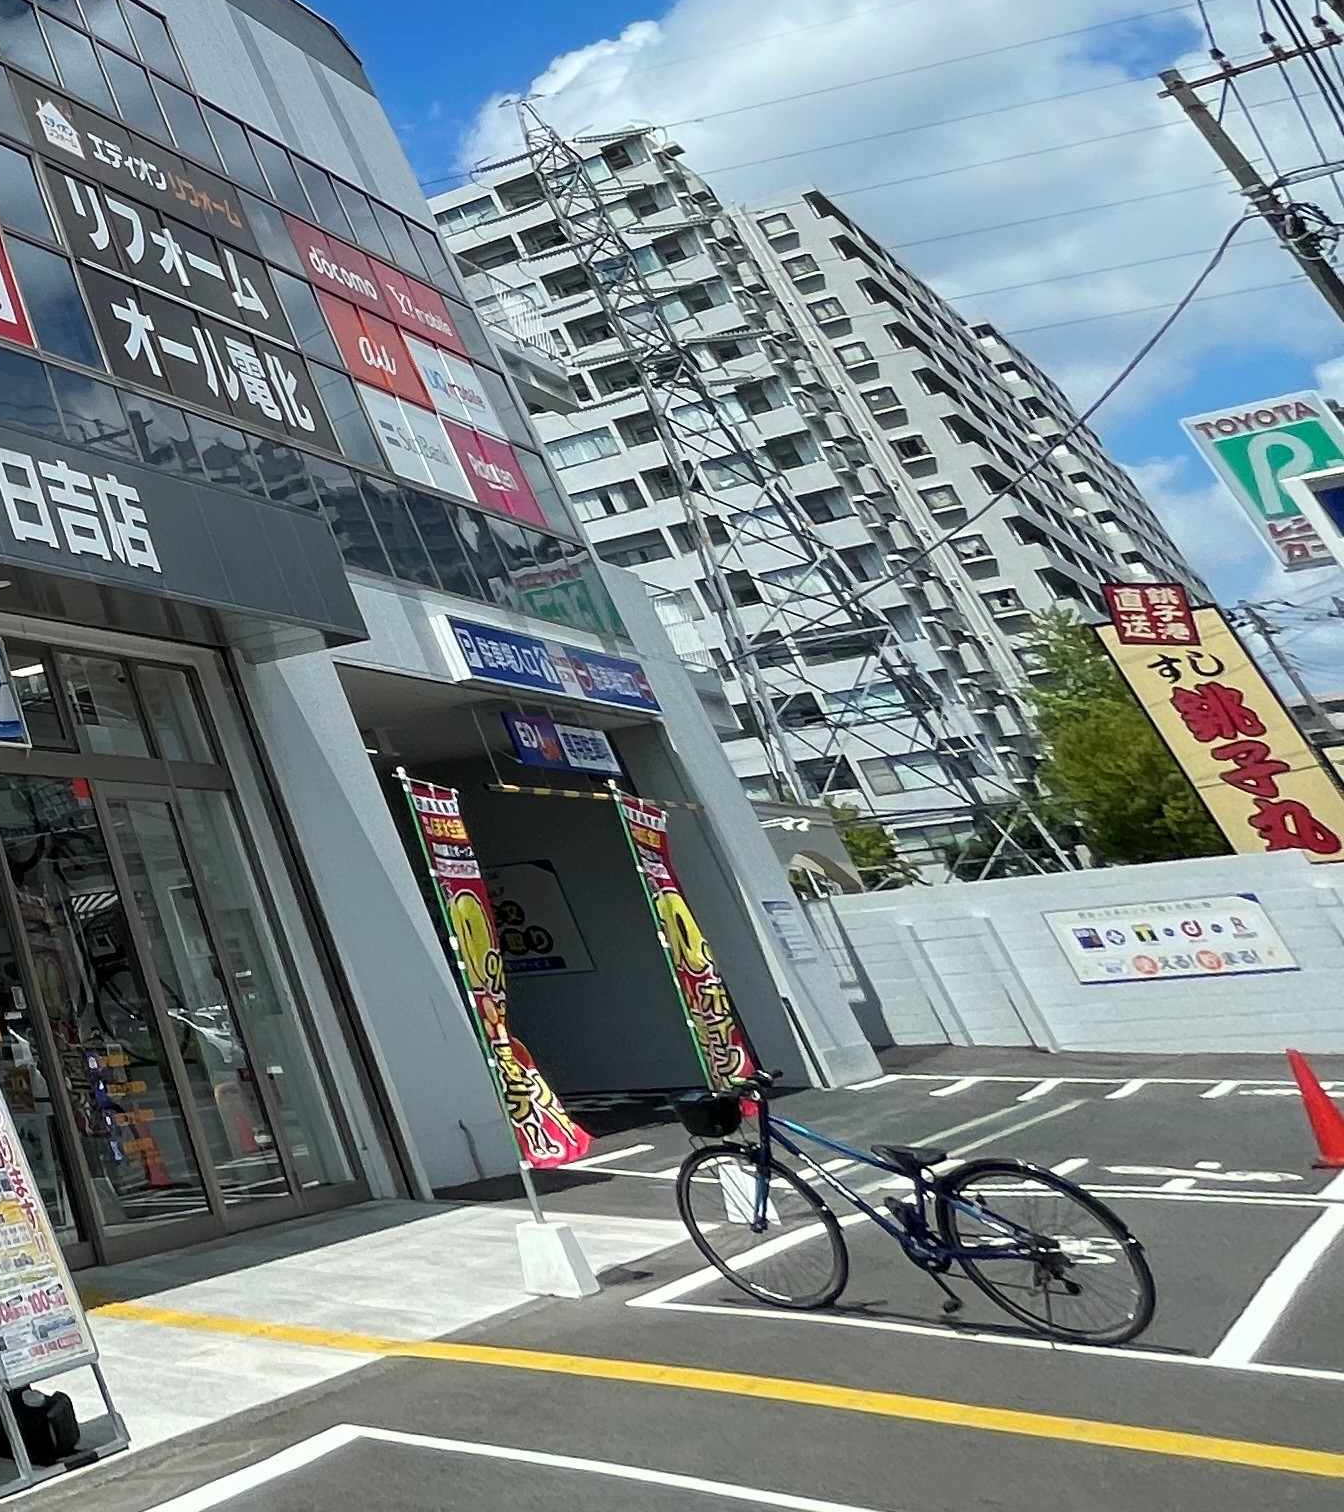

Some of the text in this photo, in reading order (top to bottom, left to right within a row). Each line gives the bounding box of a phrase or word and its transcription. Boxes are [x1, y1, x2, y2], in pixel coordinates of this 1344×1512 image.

[64, 175, 270, 320] リフォーム
[308, 245, 379, 301] docomo
[110, 296, 315, 432] オール電化
[1195, 401, 1321, 440] TOYOTA
